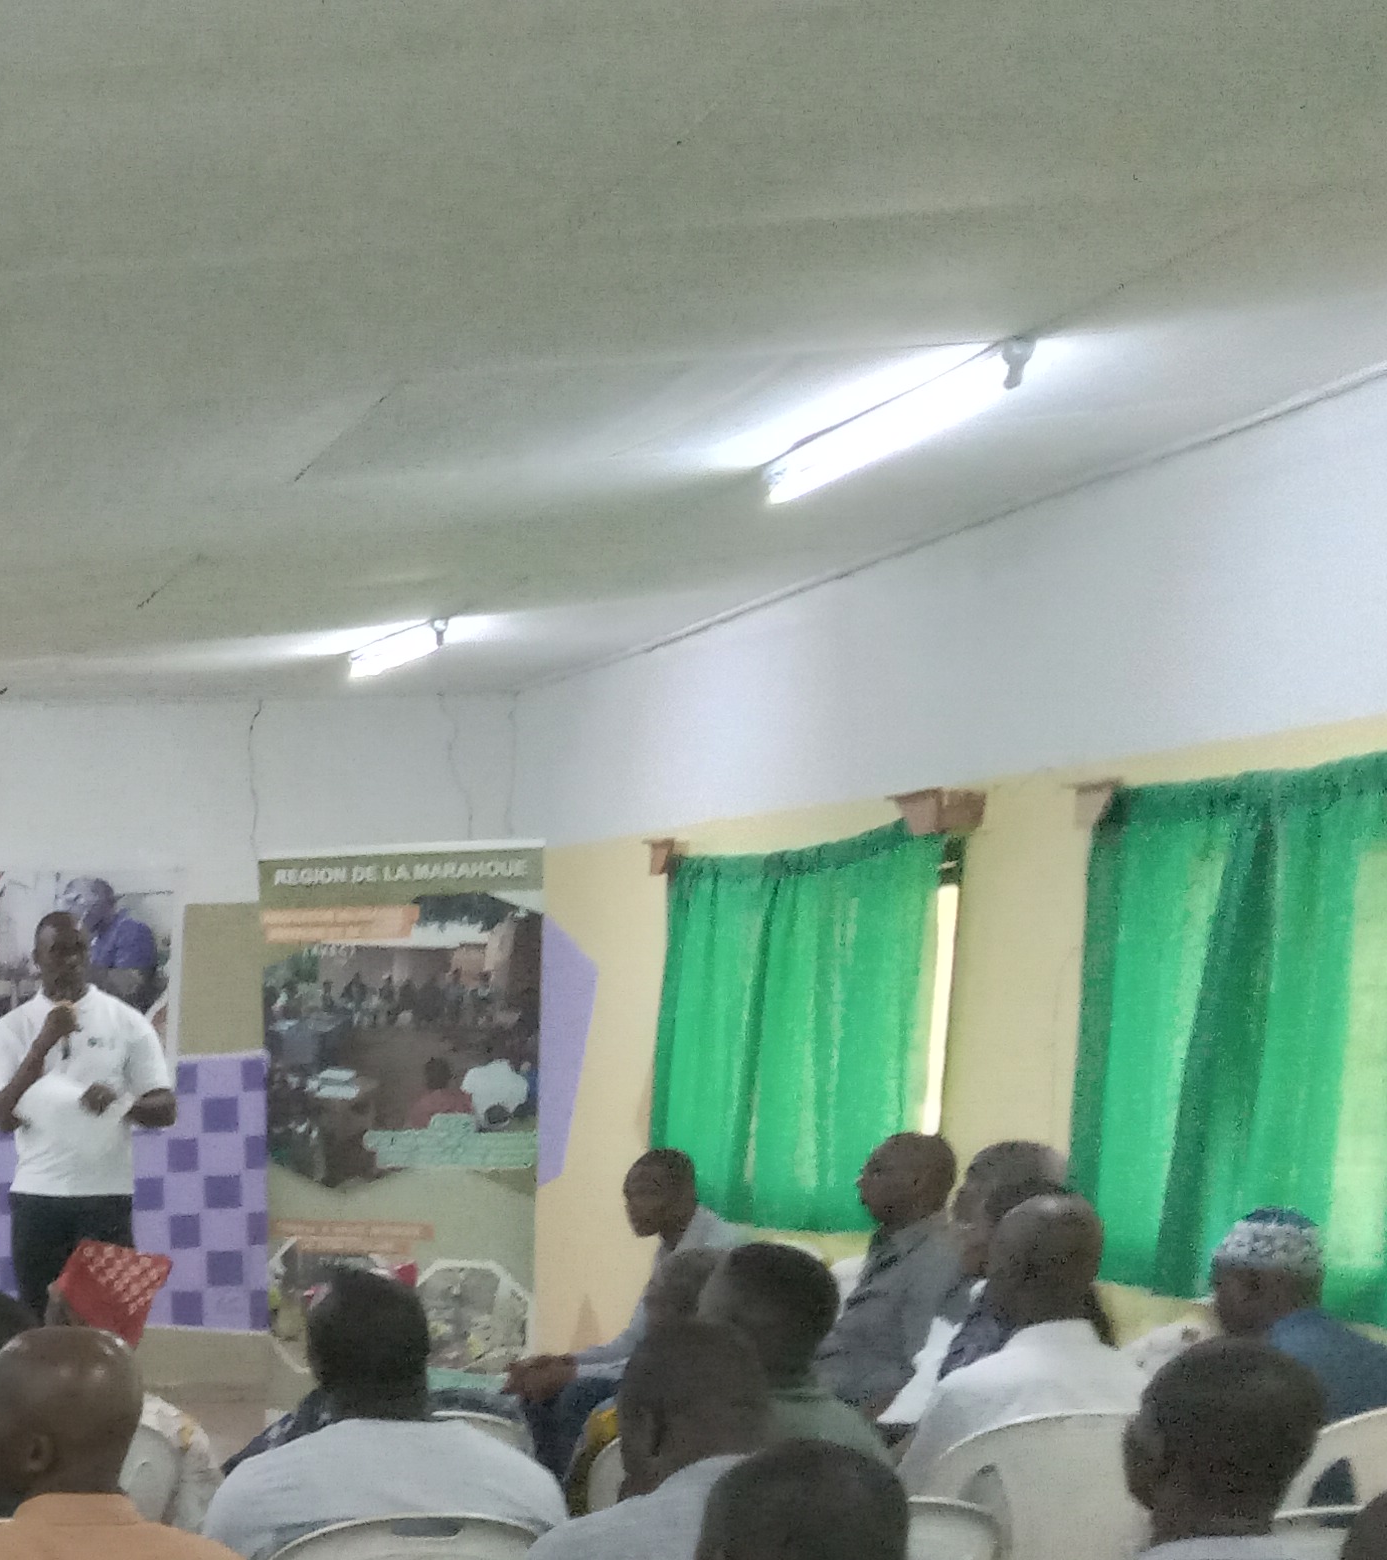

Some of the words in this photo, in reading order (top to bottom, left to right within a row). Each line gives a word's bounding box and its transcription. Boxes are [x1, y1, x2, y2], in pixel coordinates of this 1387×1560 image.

[275, 866, 347, 885] REGION
[352, 865, 377, 883] DE
[383, 863, 412, 881] LA
[414, 859, 527, 880] MARAHOUE
